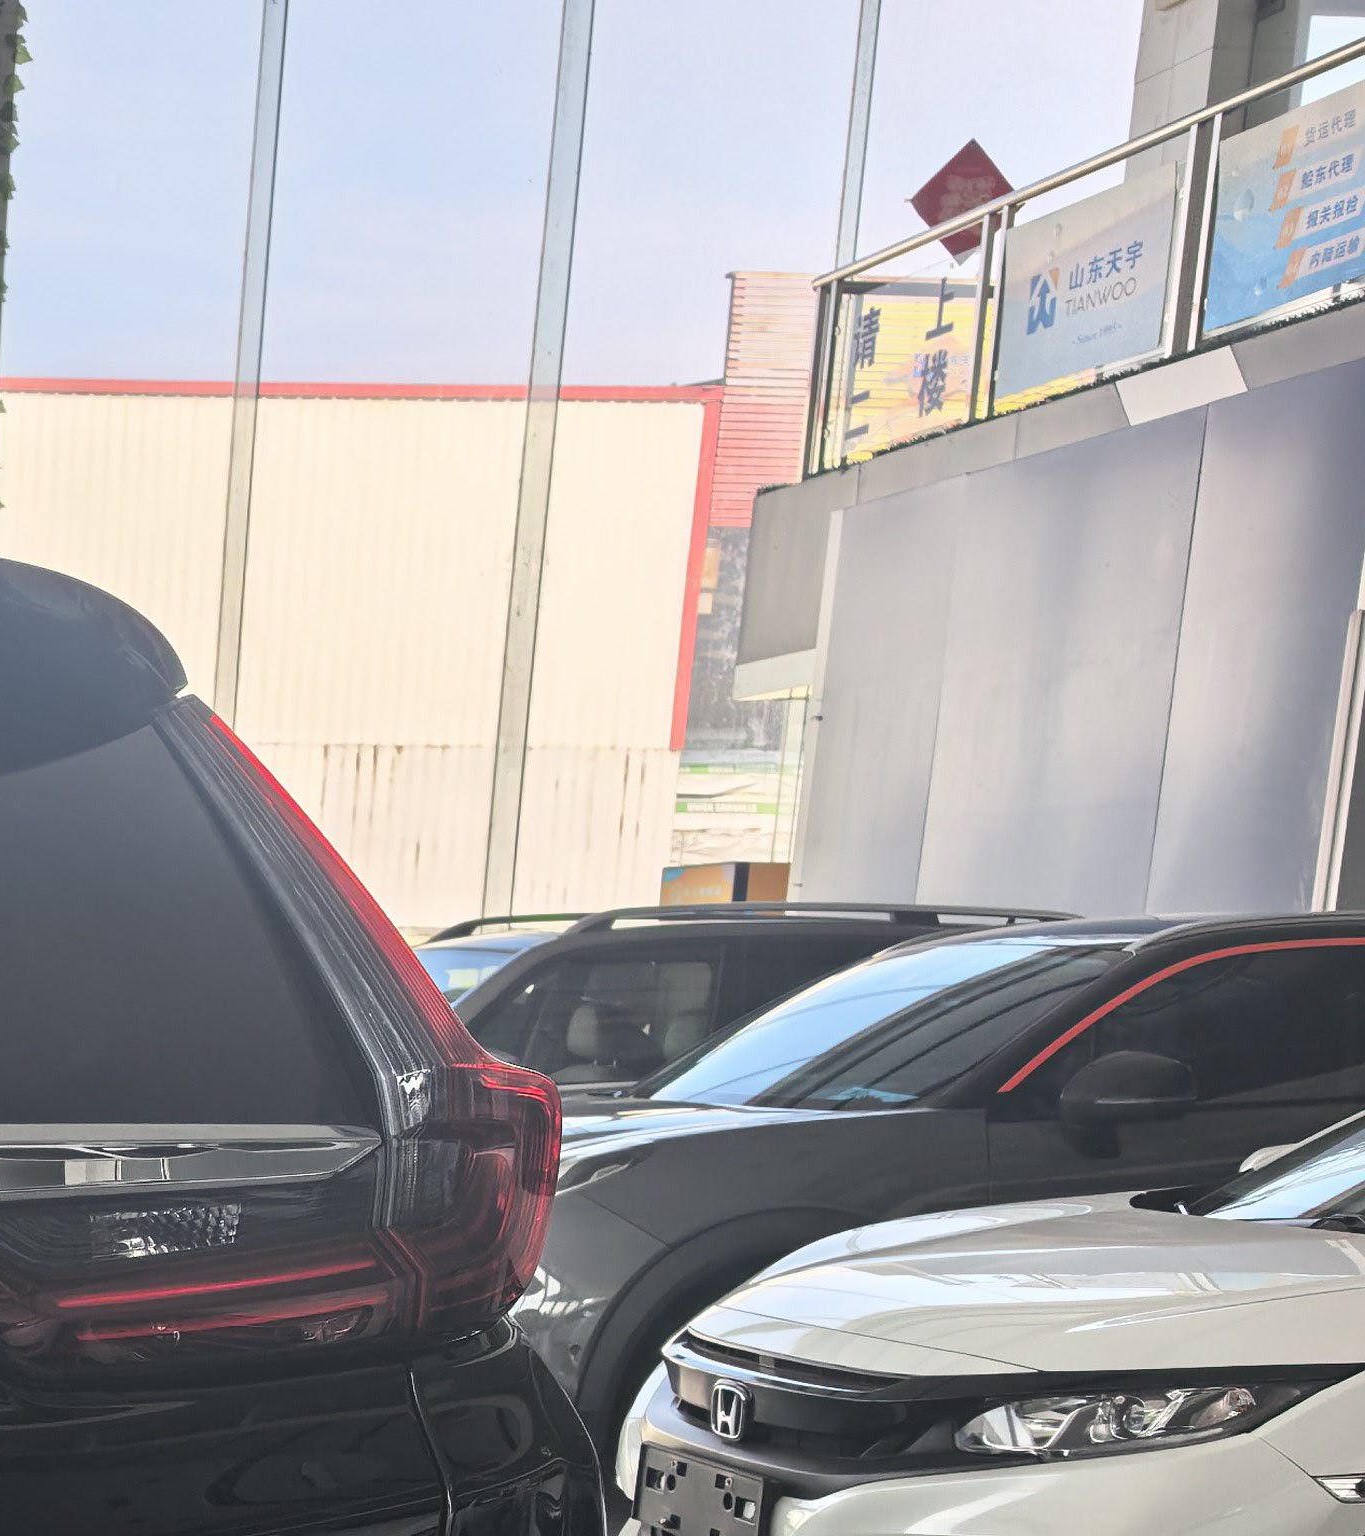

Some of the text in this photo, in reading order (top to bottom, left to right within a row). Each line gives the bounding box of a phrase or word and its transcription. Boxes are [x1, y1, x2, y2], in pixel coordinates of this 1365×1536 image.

[1300, 153, 1355, 191] 船东代理
[1068, 240, 1144, 290] 山东天宇
[1065, 276, 1137, 316] TIANWOO
